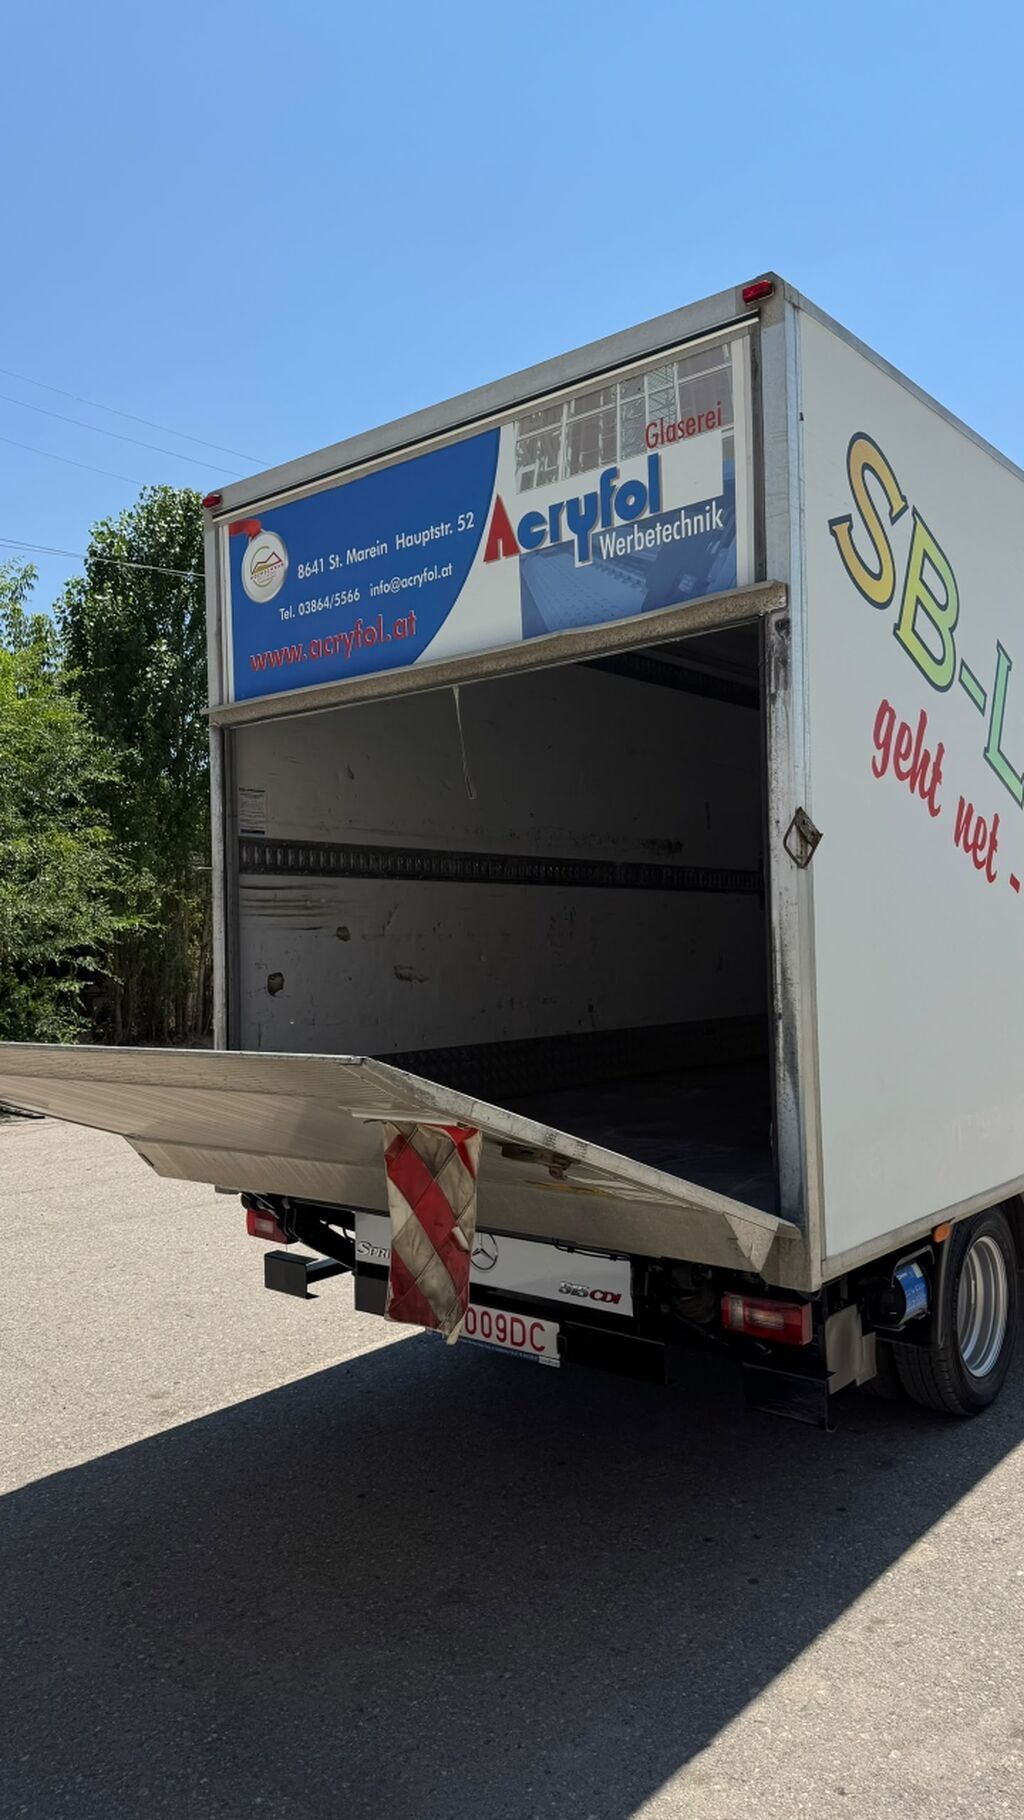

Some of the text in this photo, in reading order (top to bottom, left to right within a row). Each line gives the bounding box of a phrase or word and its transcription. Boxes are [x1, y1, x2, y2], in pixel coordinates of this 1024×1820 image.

[645, 401, 722, 450] Glaserei
[483, 452, 661, 563] Acryfol
[600, 501, 724, 560] Werbetechnik
[297, 558, 324, 580] 8641
[329, 553, 342, 571] St.
[346, 540, 389, 566] Marein
[395, 522, 453, 551] Hauptstr.
[457, 511, 475, 531] 52
[279, 563, 453, 621] Tel. 03864/5566 info@acryfol.at
[249, 610, 417, 673] www.acryfol.at
[871, 699, 945, 817] geht
[954, 795, 999, 883] net
[589, 1288, 622, 1304] CDI
[464, 1306, 546, 1352] 009DC
